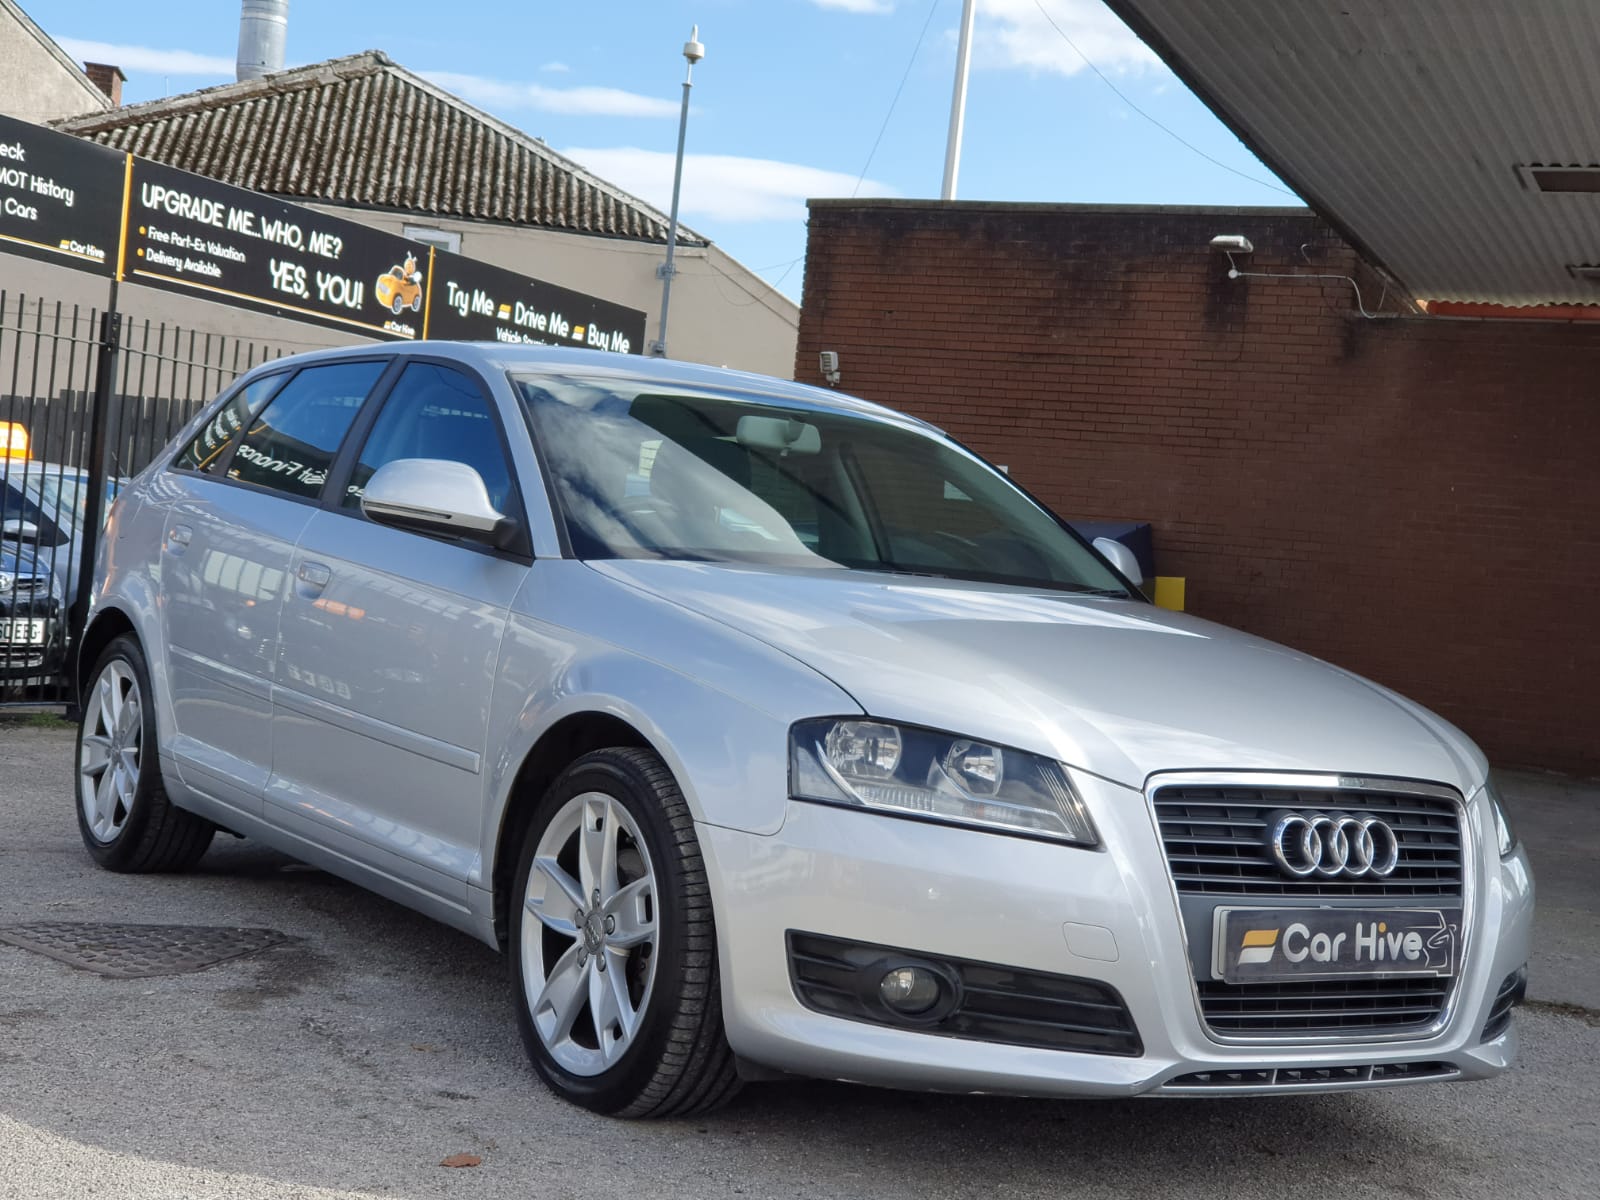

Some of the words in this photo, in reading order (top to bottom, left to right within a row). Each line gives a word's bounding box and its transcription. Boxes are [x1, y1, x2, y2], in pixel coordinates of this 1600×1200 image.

[30, 174, 74, 207] History
[5, 197, 38, 220] Cars
[142, 182, 225, 228] UPGRADE
[309, 230, 343, 260] ME?
[70, 240, 86, 254] Car
[148, 225, 169, 243] Free
[171, 231, 206, 252] Part-Ex
[207, 241, 246, 263] Valuation
[146, 247, 183, 272] Delivery
[184, 257, 222, 277] Available
[270, 258, 310, 299] YES,
[316, 270, 364, 310] YOU!
[447, 281, 470, 317] Try
[471, 288, 495, 316] Me
[514, 301, 547, 331] Drive
[549, 312, 569, 337] Me
[587, 323, 609, 351] Buy
[611, 330, 630, 354] Me
[496, 326, 522, 343] Vehicle
[1282, 922, 1346, 963] Car
[1355, 922, 1423, 961] Hive
